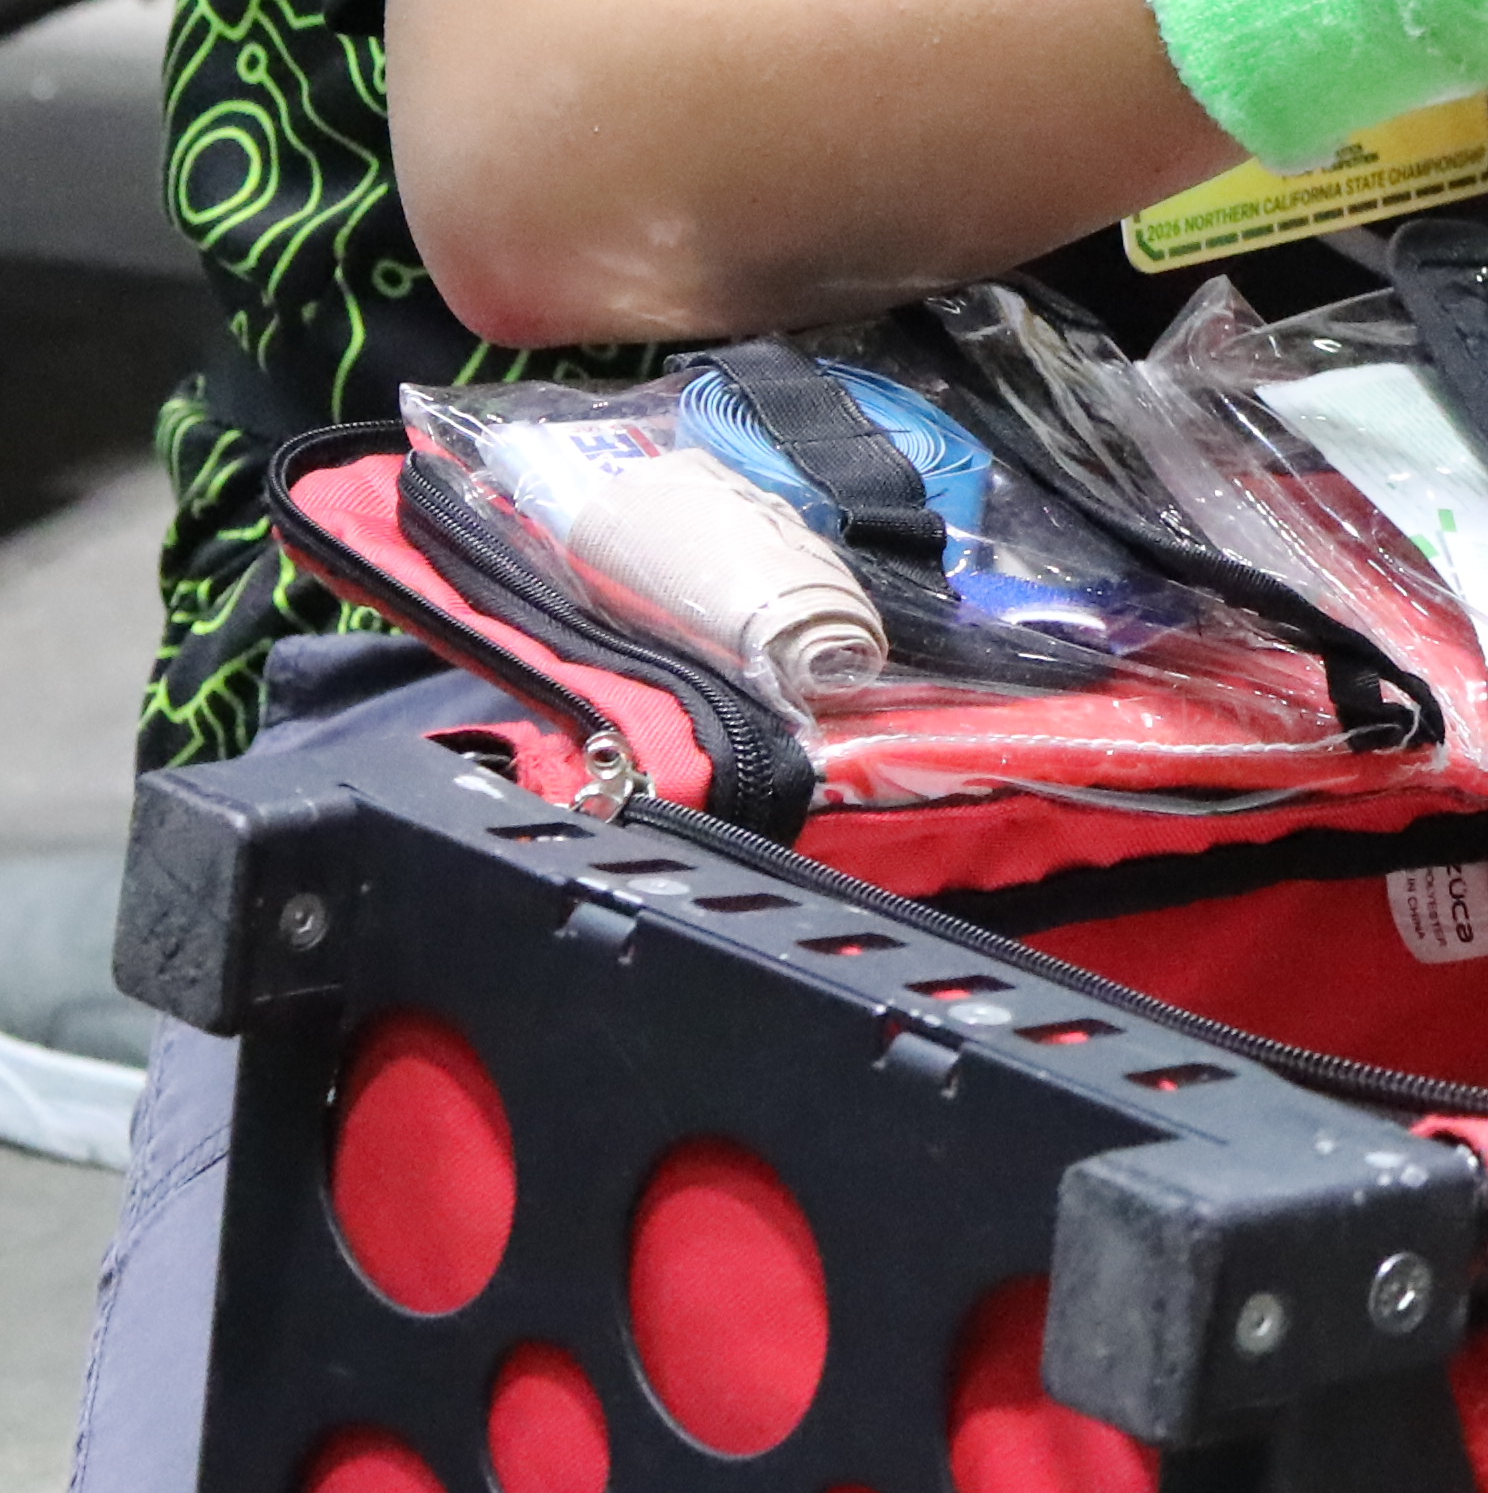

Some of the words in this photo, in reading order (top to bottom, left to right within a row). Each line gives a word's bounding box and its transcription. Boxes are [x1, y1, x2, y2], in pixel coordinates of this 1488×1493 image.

[1147, 222, 1181, 242] 2026
[1184, 199, 1261, 234] NORTHERN
[1263, 180, 1343, 217] CALIFORNIA
[1344, 169, 1387, 200] STATE
[1406, 877, 1416, 893] IN
[1425, 867, 1448, 948] OLYESTER
[1407, 896, 1426, 941] CHINA
